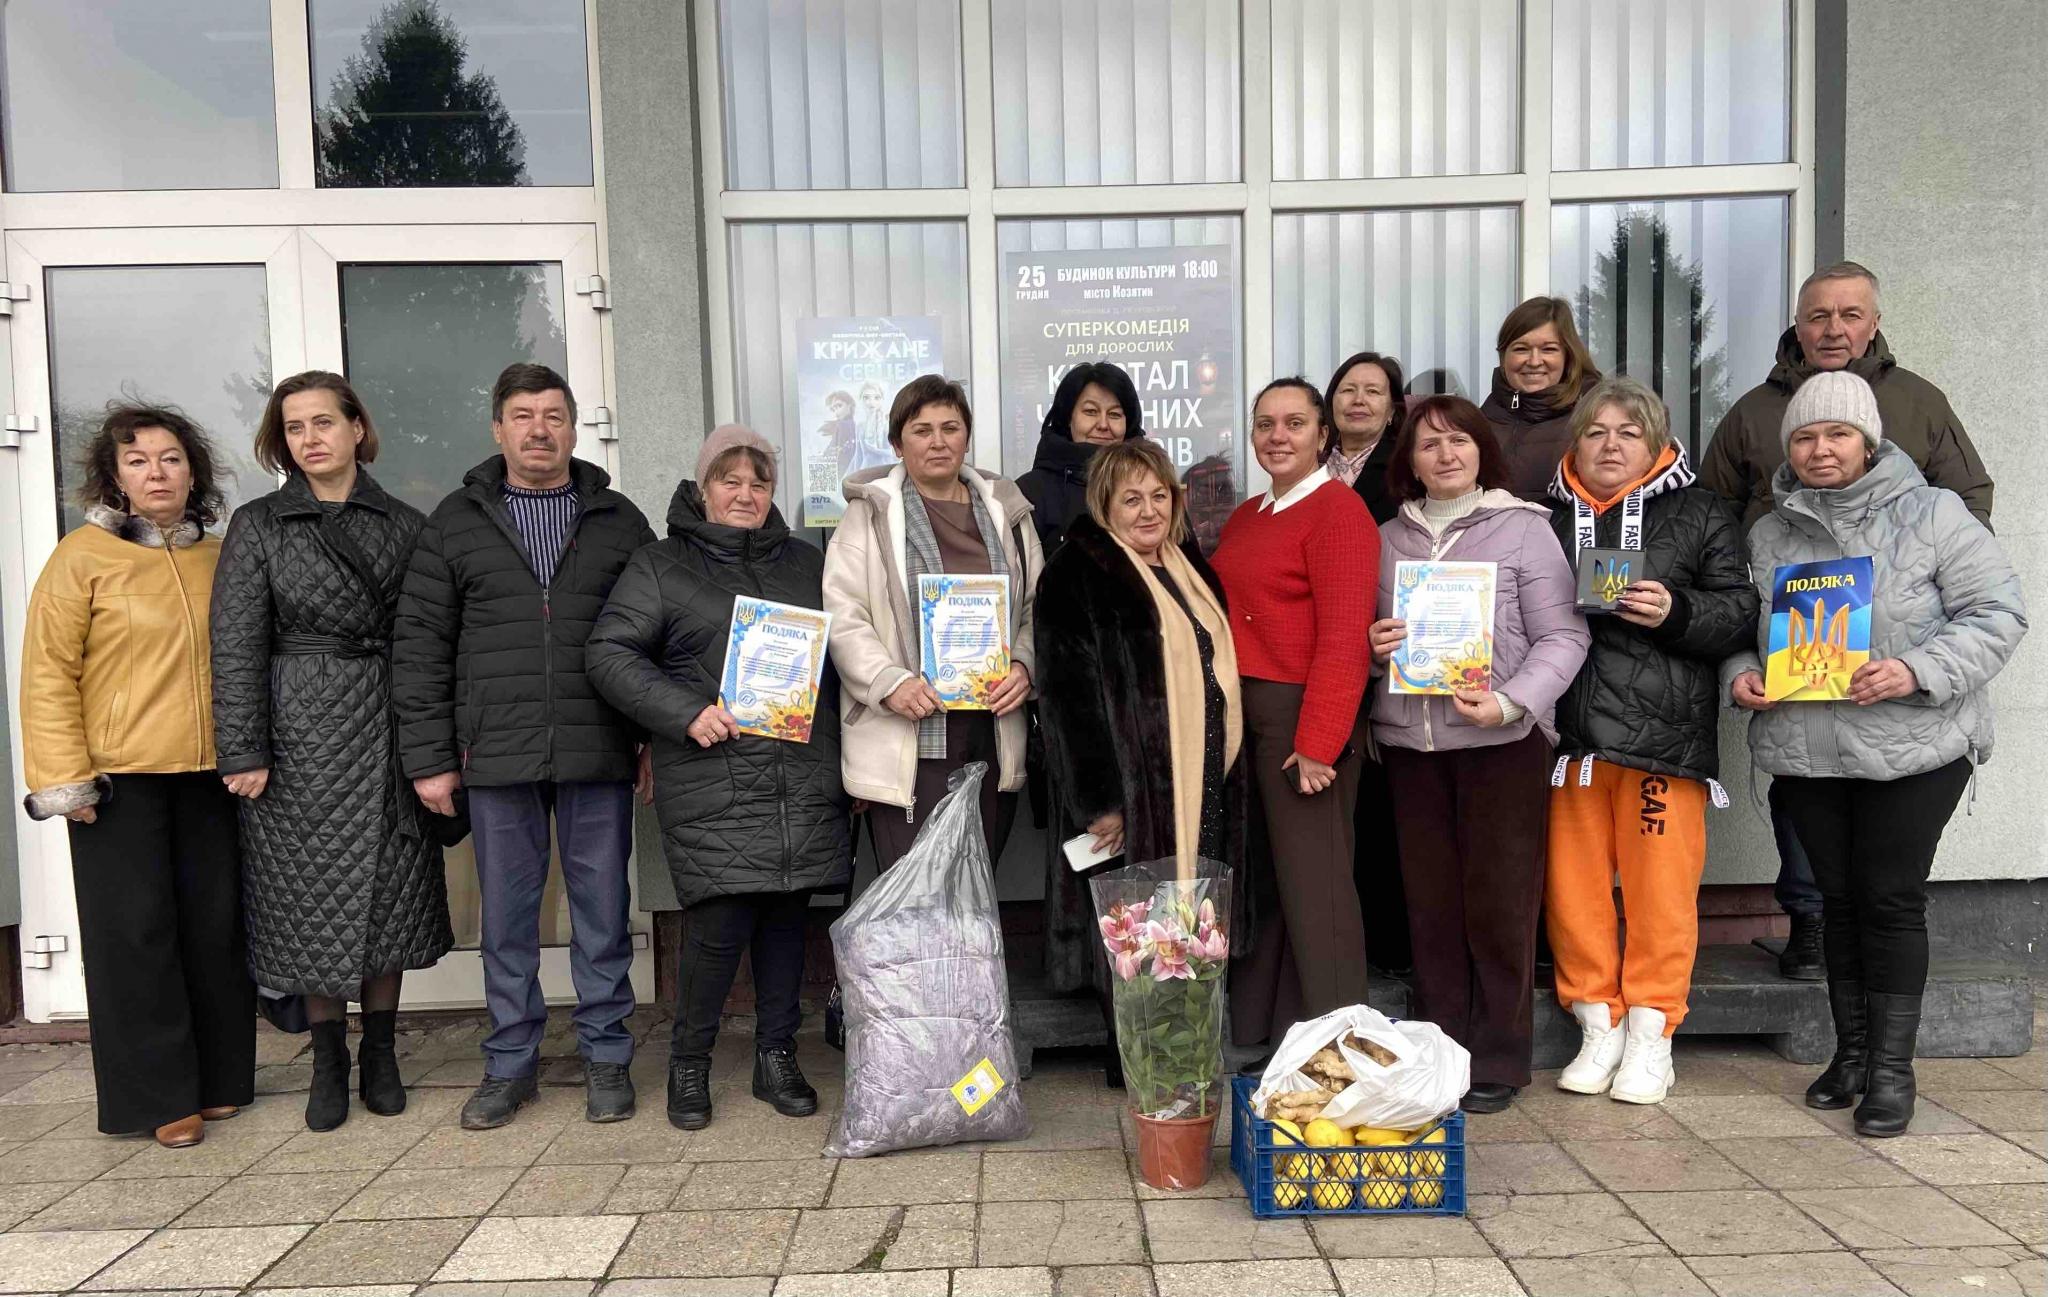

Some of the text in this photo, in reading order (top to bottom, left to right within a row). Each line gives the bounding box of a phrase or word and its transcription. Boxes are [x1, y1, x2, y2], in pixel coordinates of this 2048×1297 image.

[1018, 266, 1046, 288] 25
[1057, 264, 1176, 283] БУДИНОК КУЛЬТУРИ
[1183, 260, 1218, 279] 18:00
[1016, 290, 1049, 301] ГРУДНЯ
[1043, 318, 1190, 338] СУПЕРКОМЕДІЯ
[813, 340, 930, 360] КРИЖАНЕ
[1065, 340, 1175, 356] ДЛЯ ДОРОСЛИХ
[1048, 360, 1189, 395] КТАЛ
[1427, 583, 1474, 592] ПОДЯКА
[1786, 573, 1856, 593] ПОДЯКА
[949, 597, 992, 607] ПОДЯКА
[761, 623, 808, 641] ПОДЯКА
